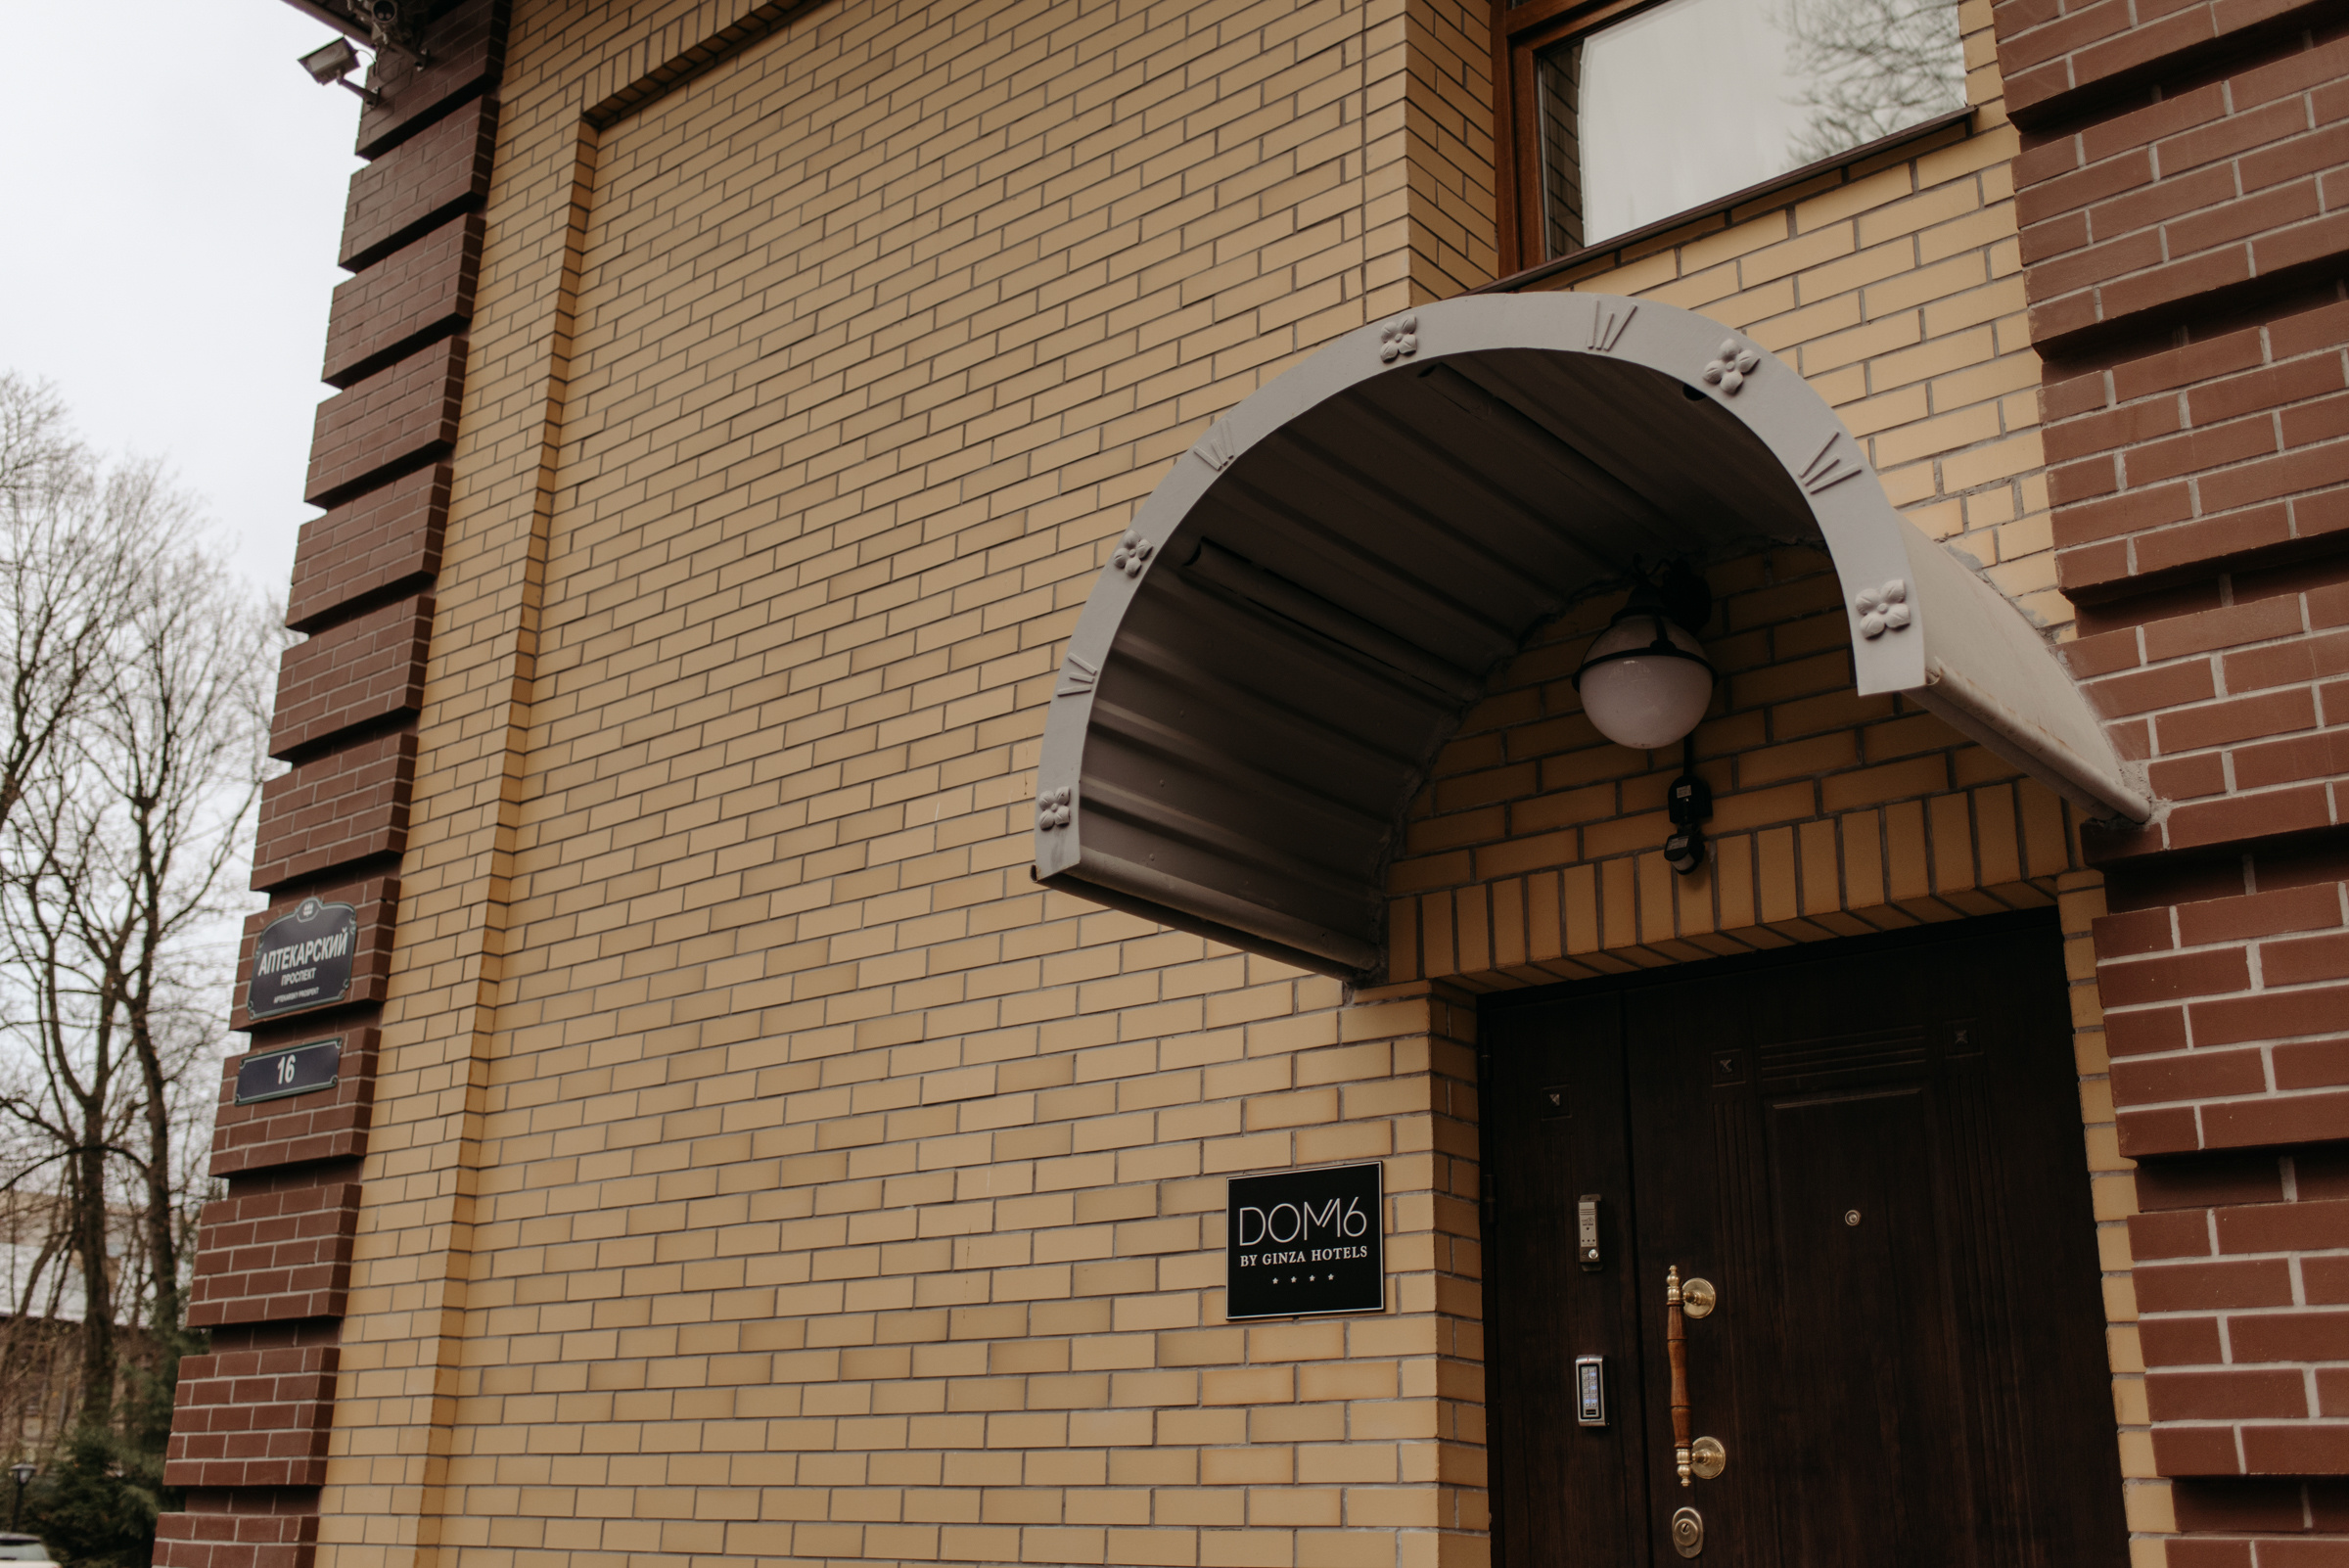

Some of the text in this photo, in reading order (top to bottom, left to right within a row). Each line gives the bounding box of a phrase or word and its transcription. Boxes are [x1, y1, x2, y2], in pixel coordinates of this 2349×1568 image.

[257, 926, 348, 977] АПТЕКАРСКИЙ
[280, 967, 317, 987] ПРОСПЕКТ
[277, 1054, 297, 1084] 16
[1240, 1245, 1368, 1268] BY GINZA HOTELS
